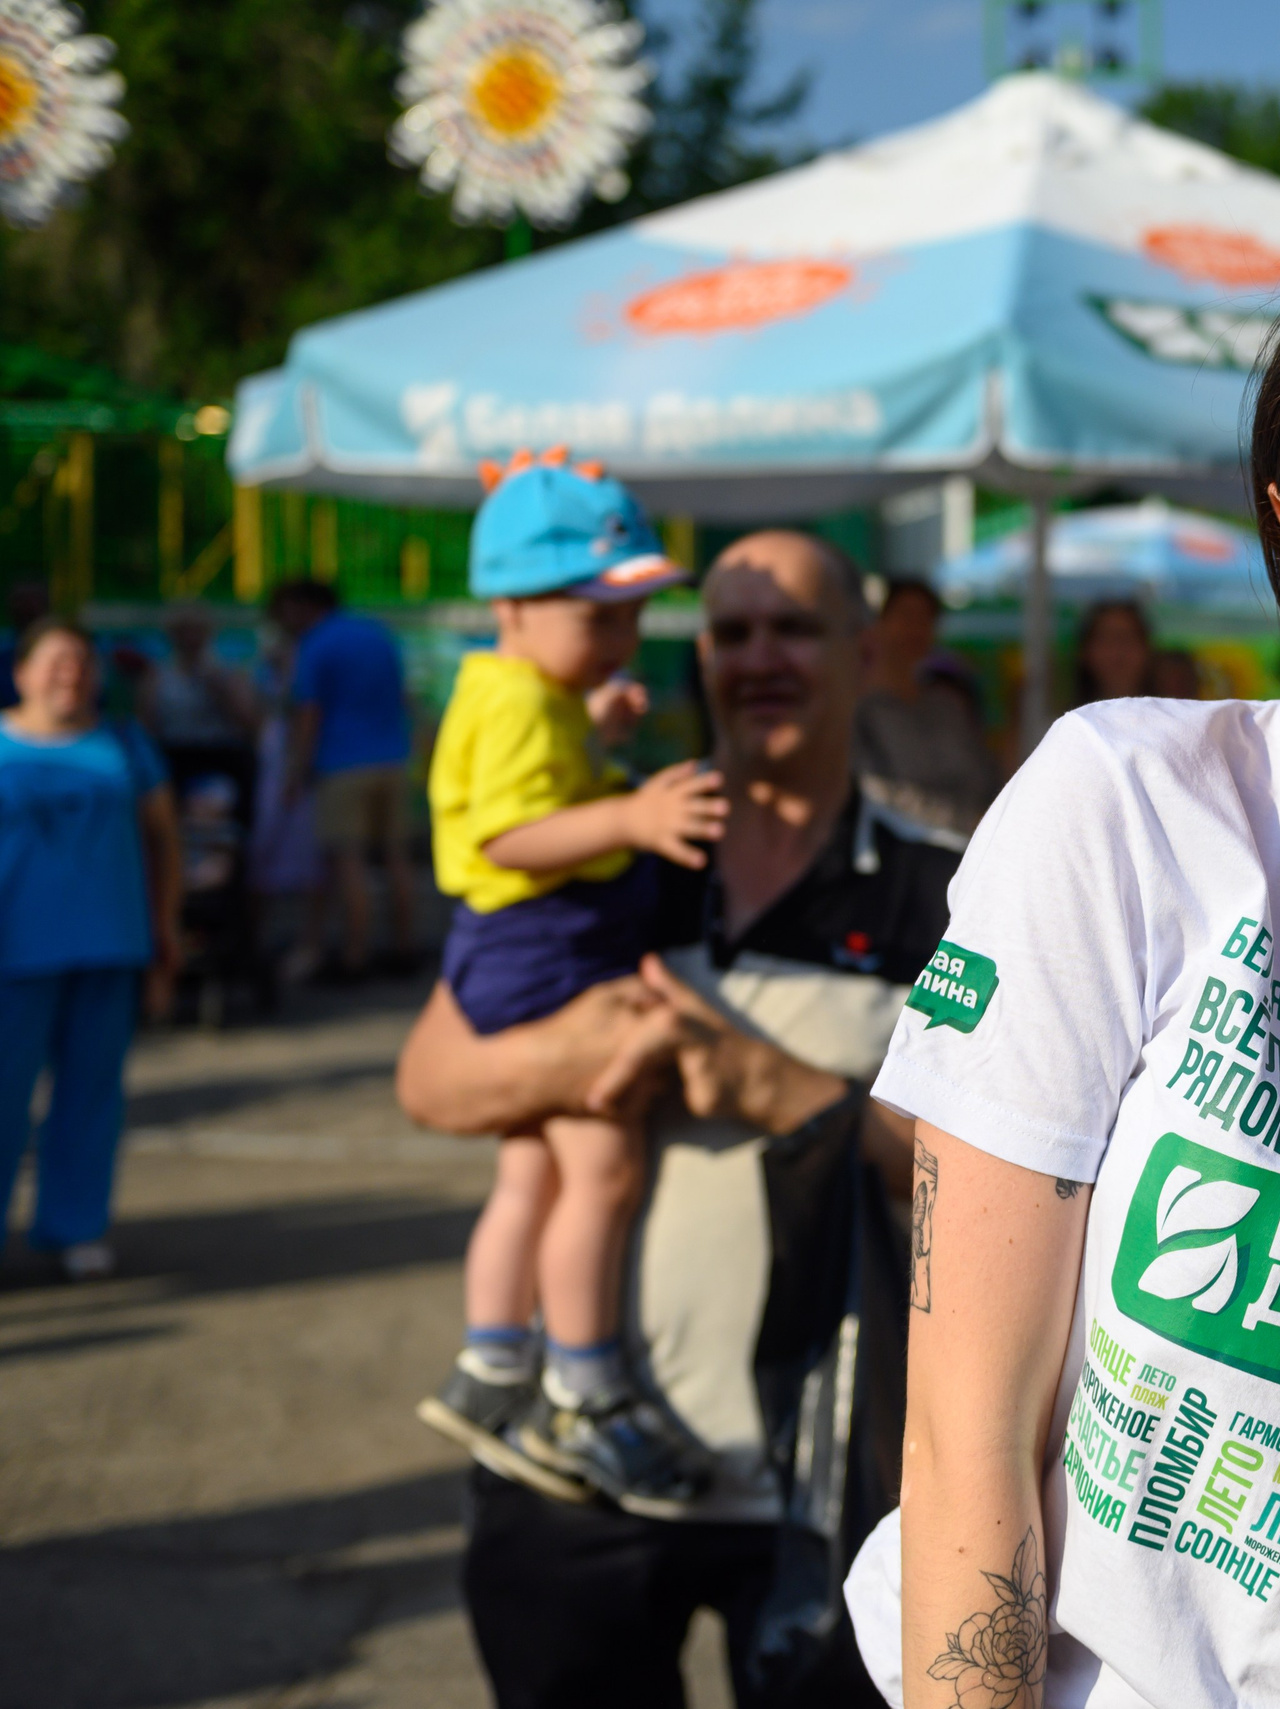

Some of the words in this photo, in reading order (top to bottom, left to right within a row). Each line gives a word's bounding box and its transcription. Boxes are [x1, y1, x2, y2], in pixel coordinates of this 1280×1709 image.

[914, 968, 978, 1009] лина
[929, 950, 965, 978] ая
[1089, 1317, 1137, 1387] ОЛНЦЕ
[1137, 1363, 1177, 1393] ЛЕТО
[1130, 1384, 1170, 1411] ПЛЯЖ
[1069, 1385, 1147, 1493] СЧАСТЬЕ
[1127, 1387, 1218, 1552] ПЛОМБИР
[1058, 1430, 1127, 1534] ГАРМОНИЯ
[1196, 1440, 1264, 1534] ЛЕТО
[1174, 1520, 1280, 1603] СОЛНЦЕ
